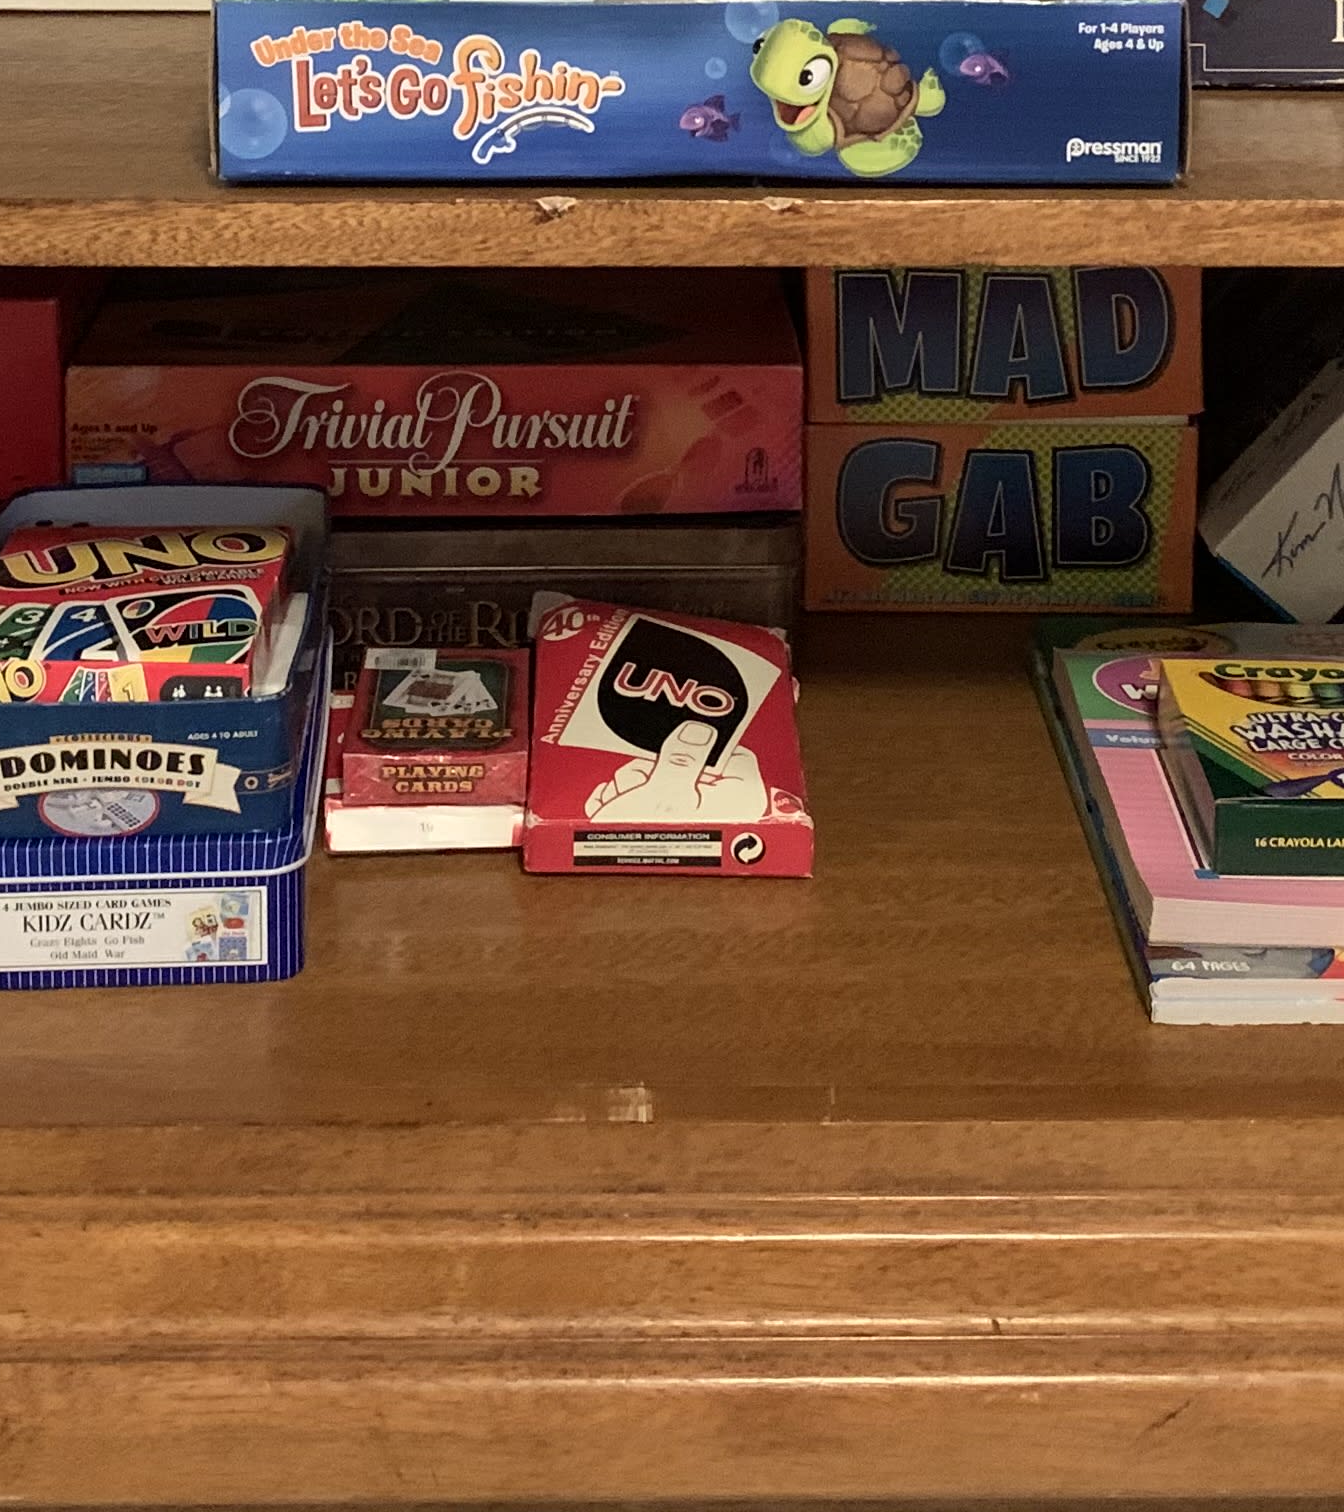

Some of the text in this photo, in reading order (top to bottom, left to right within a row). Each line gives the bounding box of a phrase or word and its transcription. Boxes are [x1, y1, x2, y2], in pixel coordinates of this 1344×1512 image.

[1078, 22, 1165, 37] For 1-4 Players
[251, 21, 444, 67] Under the Sea
[1093, 39, 1165, 53] Ages 4 Up
[293, 56, 451, 132] Let's Go
[836, 266, 1173, 402] MAD
[72, 423, 158, 435] Ages and Up
[228, 369, 635, 475] Trivial Pursuit
[327, 466, 544, 499] JUNIOR
[837, 437, 1153, 583] GAB
[2, 528, 288, 585] UNO
[64, 577, 148, 595] NOW WITH
[13, 608, 45, 625] 3
[70, 607, 98, 624] 4
[146, 618, 260, 644] WILD
[540, 608, 630, 745] Anniversary Edition
[612, 660, 736, 718] UNO
[382, 718, 494, 729] CARDS
[187, 729, 259, 741] AGES ADULT
[360, 728, 514, 738] PLAYING
[1250, 738, 1324, 753] LARGE
[0, 748, 206, 779] DOMINOES
[1287, 752, 1344, 762] COLOR
[381, 765, 485, 779] PLAYING
[3, 775, 131, 792] DOUBLE NINE JUMBO
[394, 780, 474, 794] CARDS
[586, 832, 711, 841] CONSUMER INFORMATION
[1254, 838, 1268, 849] 16
[1268, 837, 1325, 849] CRAYOLA
[2, 898, 172, 912] 4 JUMBO SIZED CARD GAMES
[22, 911, 154, 933] KIDZ CARDZ
[29, 935, 145, 949] Crazy Eights Go Fish
[49, 949, 126, 960] Old Maid War
[1171, 960, 1251, 973] 64 PAGES
